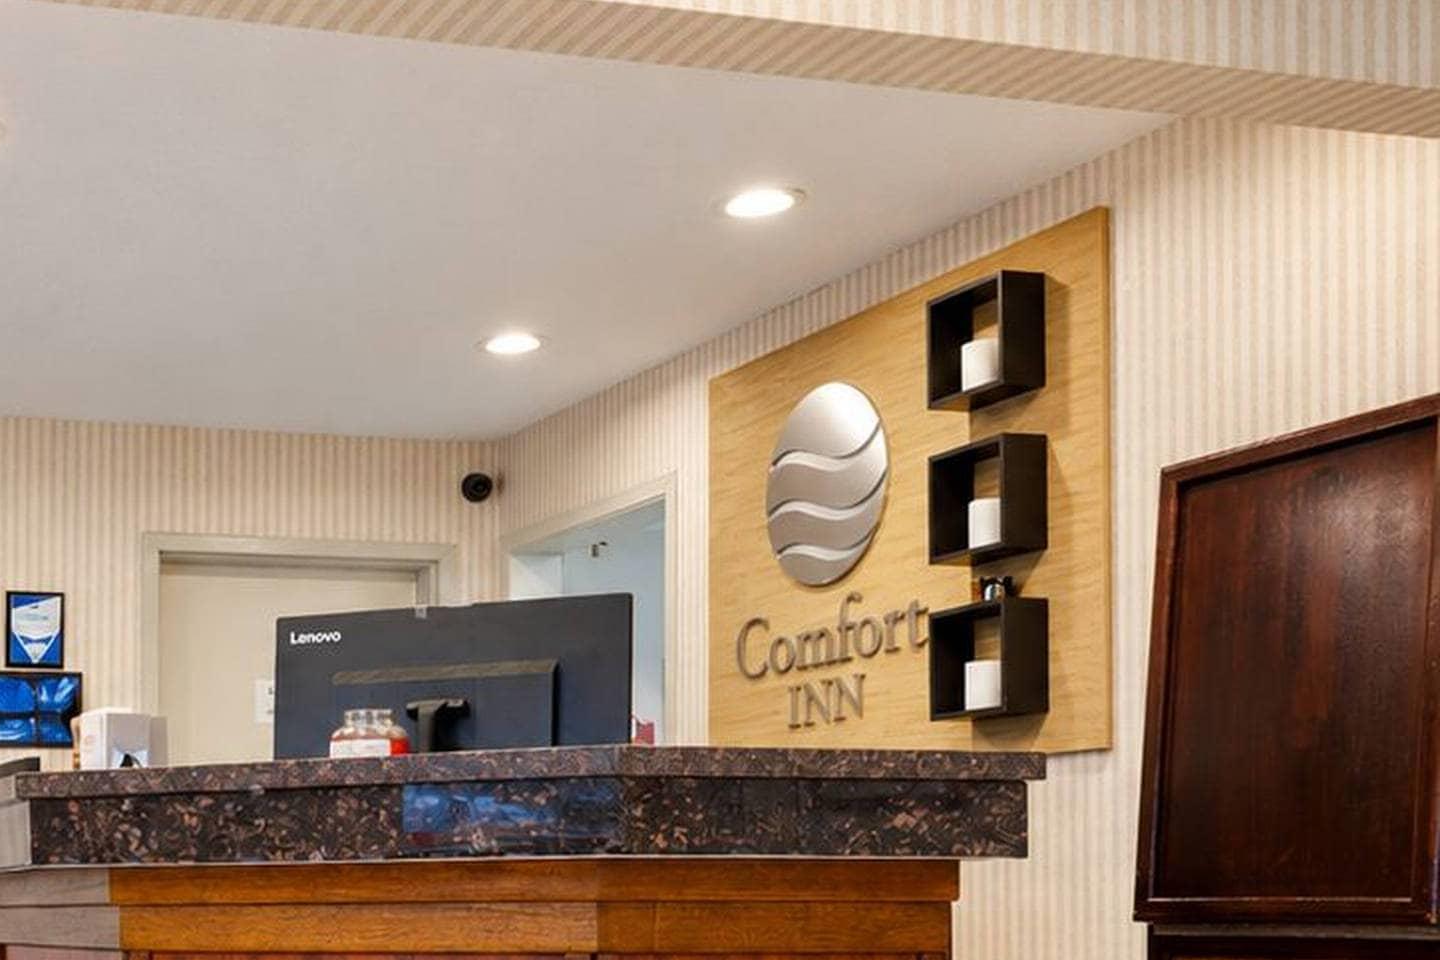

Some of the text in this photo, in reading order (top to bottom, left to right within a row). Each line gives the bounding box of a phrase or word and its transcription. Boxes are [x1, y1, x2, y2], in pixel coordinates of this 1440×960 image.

[290, 631, 341, 644] Lenovo
[736, 591, 929, 680] Comfort
[787, 672, 866, 729] INN
